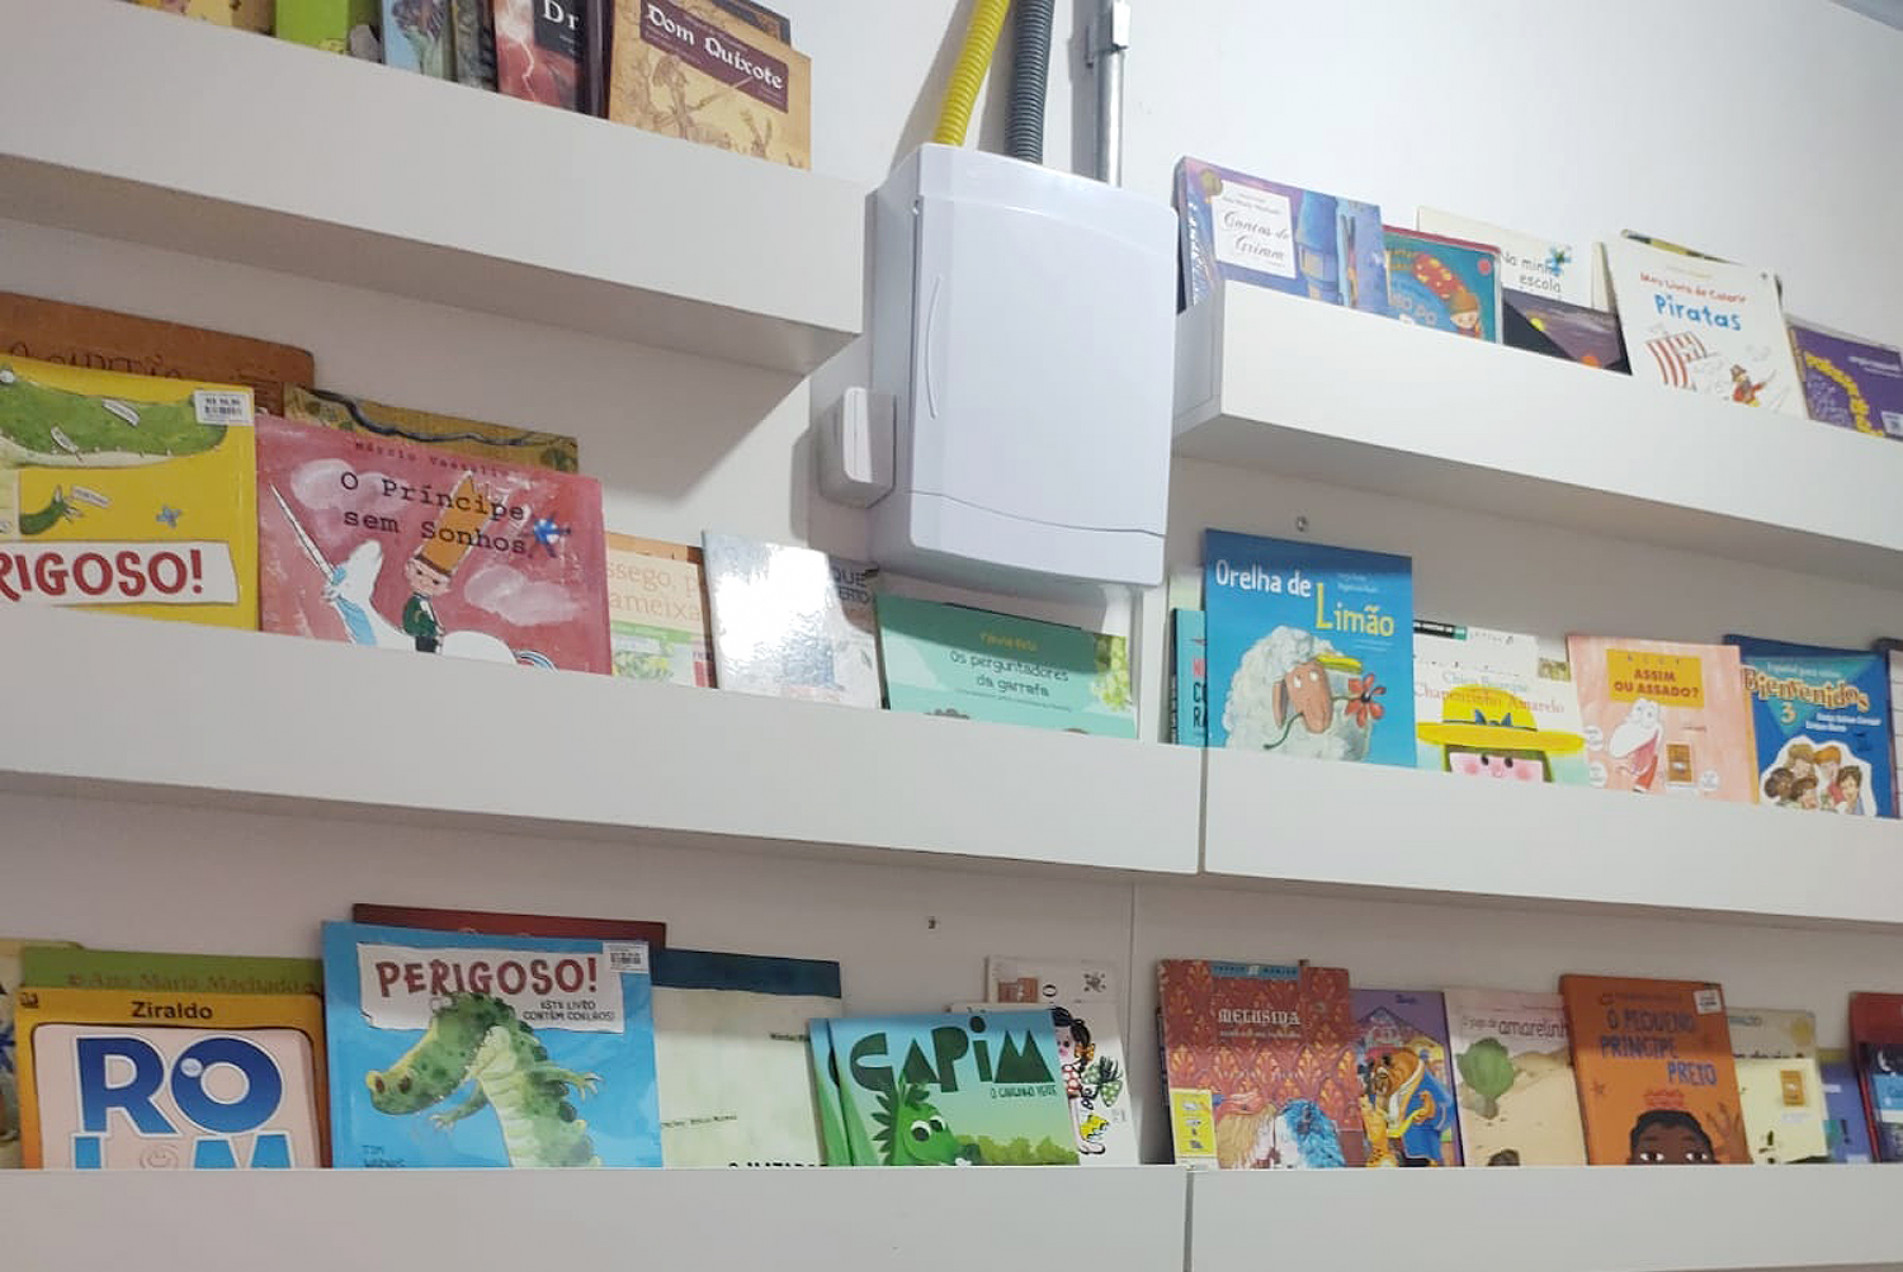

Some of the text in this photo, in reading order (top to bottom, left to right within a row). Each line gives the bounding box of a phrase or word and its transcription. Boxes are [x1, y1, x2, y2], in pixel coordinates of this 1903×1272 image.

[646, 5, 784, 91] Dom Quixote
[1519, 274, 1561, 294] escola
[1654, 293, 1741, 332] Piratas
[340, 471, 524, 522] O Príncipe
[343, 510, 399, 534] sem
[1215, 558, 1282, 595] Orelha
[1287, 568, 1312, 599] de
[609, 591, 701, 622] ameixa
[1315, 581, 1395, 638] Limão
[970, 654, 1070, 682] perguntadores
[1633, 668, 1677, 683] ASSIM
[997, 678, 1050, 698] garrafa
[1613, 680, 1699, 698] OU ASSADO?
[1780, 701, 1798, 725] 3
[375, 955, 597, 997] PERIGOSO!
[131, 1000, 214, 1020] Ziraldo
[75, 1033, 285, 1137] RO
[1667, 1061, 1718, 1086] PRETO
